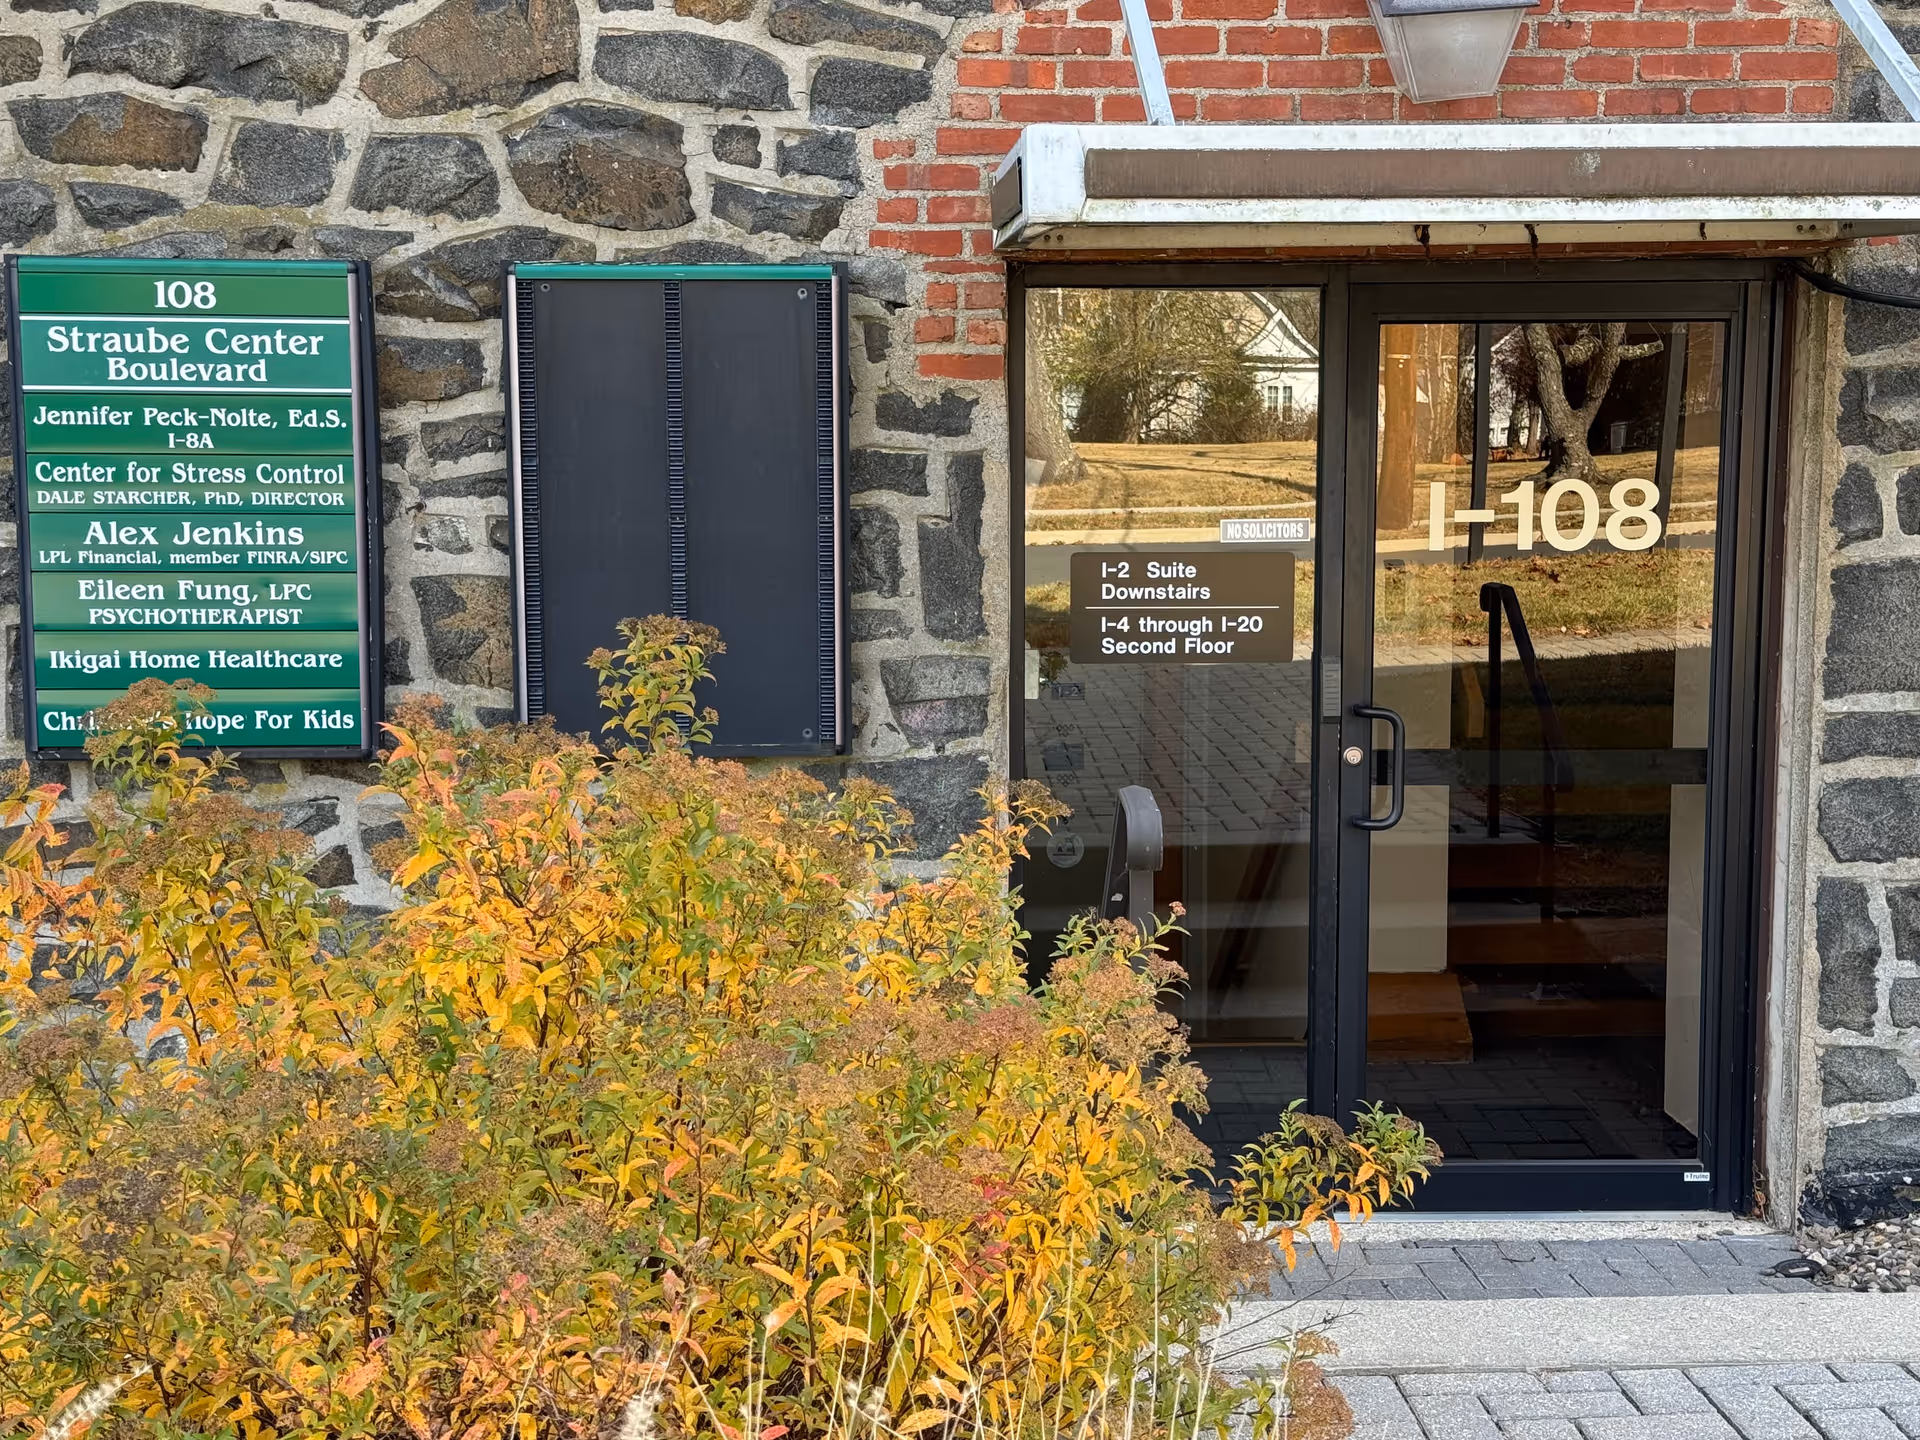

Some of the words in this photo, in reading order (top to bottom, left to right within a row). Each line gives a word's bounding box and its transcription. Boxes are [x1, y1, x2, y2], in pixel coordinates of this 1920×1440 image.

[155, 279, 218, 310] 108
[47, 325, 190, 354] Straube
[205, 327, 324, 356] Center
[107, 356, 268, 382] Boulevard
[33, 406, 133, 426] Jennifer
[143, 407, 279, 430] Peck-Nolte,
[288, 408, 348, 429] Ed.S.
[168, 433, 215, 449] I-8A
[35, 461, 116, 483] Center
[127, 461, 161, 484] for
[171, 463, 247, 484] Stress
[255, 463, 345, 485] Control
[36, 490, 86, 505] DALE
[93, 491, 197, 507] STARCHER,
[204, 491, 244, 507] PhD,
[251, 492, 346, 506] DIRECTOR
[1429, 478, 1662, 551] I-108
[83, 521, 159, 546] Alex
[173, 521, 305, 546] Jenkins
[1227, 523, 1241, 538] NO
[1242, 522, 1304, 538] SOLICITORS
[39, 550, 72, 564] LPL
[78, 550, 163, 566] Financial,
[169, 550, 240, 565] member
[247, 550, 348, 565] FINRA/SIPC
[1101, 562, 1130, 578] I-2
[1146, 561, 1197, 579] Suite
[78, 579, 165, 600] Eileen
[177, 580, 258, 606] Fung,
[269, 583, 312, 600] LPC
[1101, 584, 1211, 600] Downstairs
[89, 608, 303, 625] PSYCHOTHERAPIST
[1101, 616, 1130, 632] I-4
[1138, 617, 1213, 636] through
[1221, 616, 1263, 633] I-20
[1101, 638, 1176, 654] Second
[1184, 638, 1235, 654] Floor
[49, 650, 121, 674] Ikigai
[129, 650, 200, 669] Home
[208, 650, 343, 669] Healthcare
[255, 710, 294, 730] For
[303, 709, 355, 730] Kids
